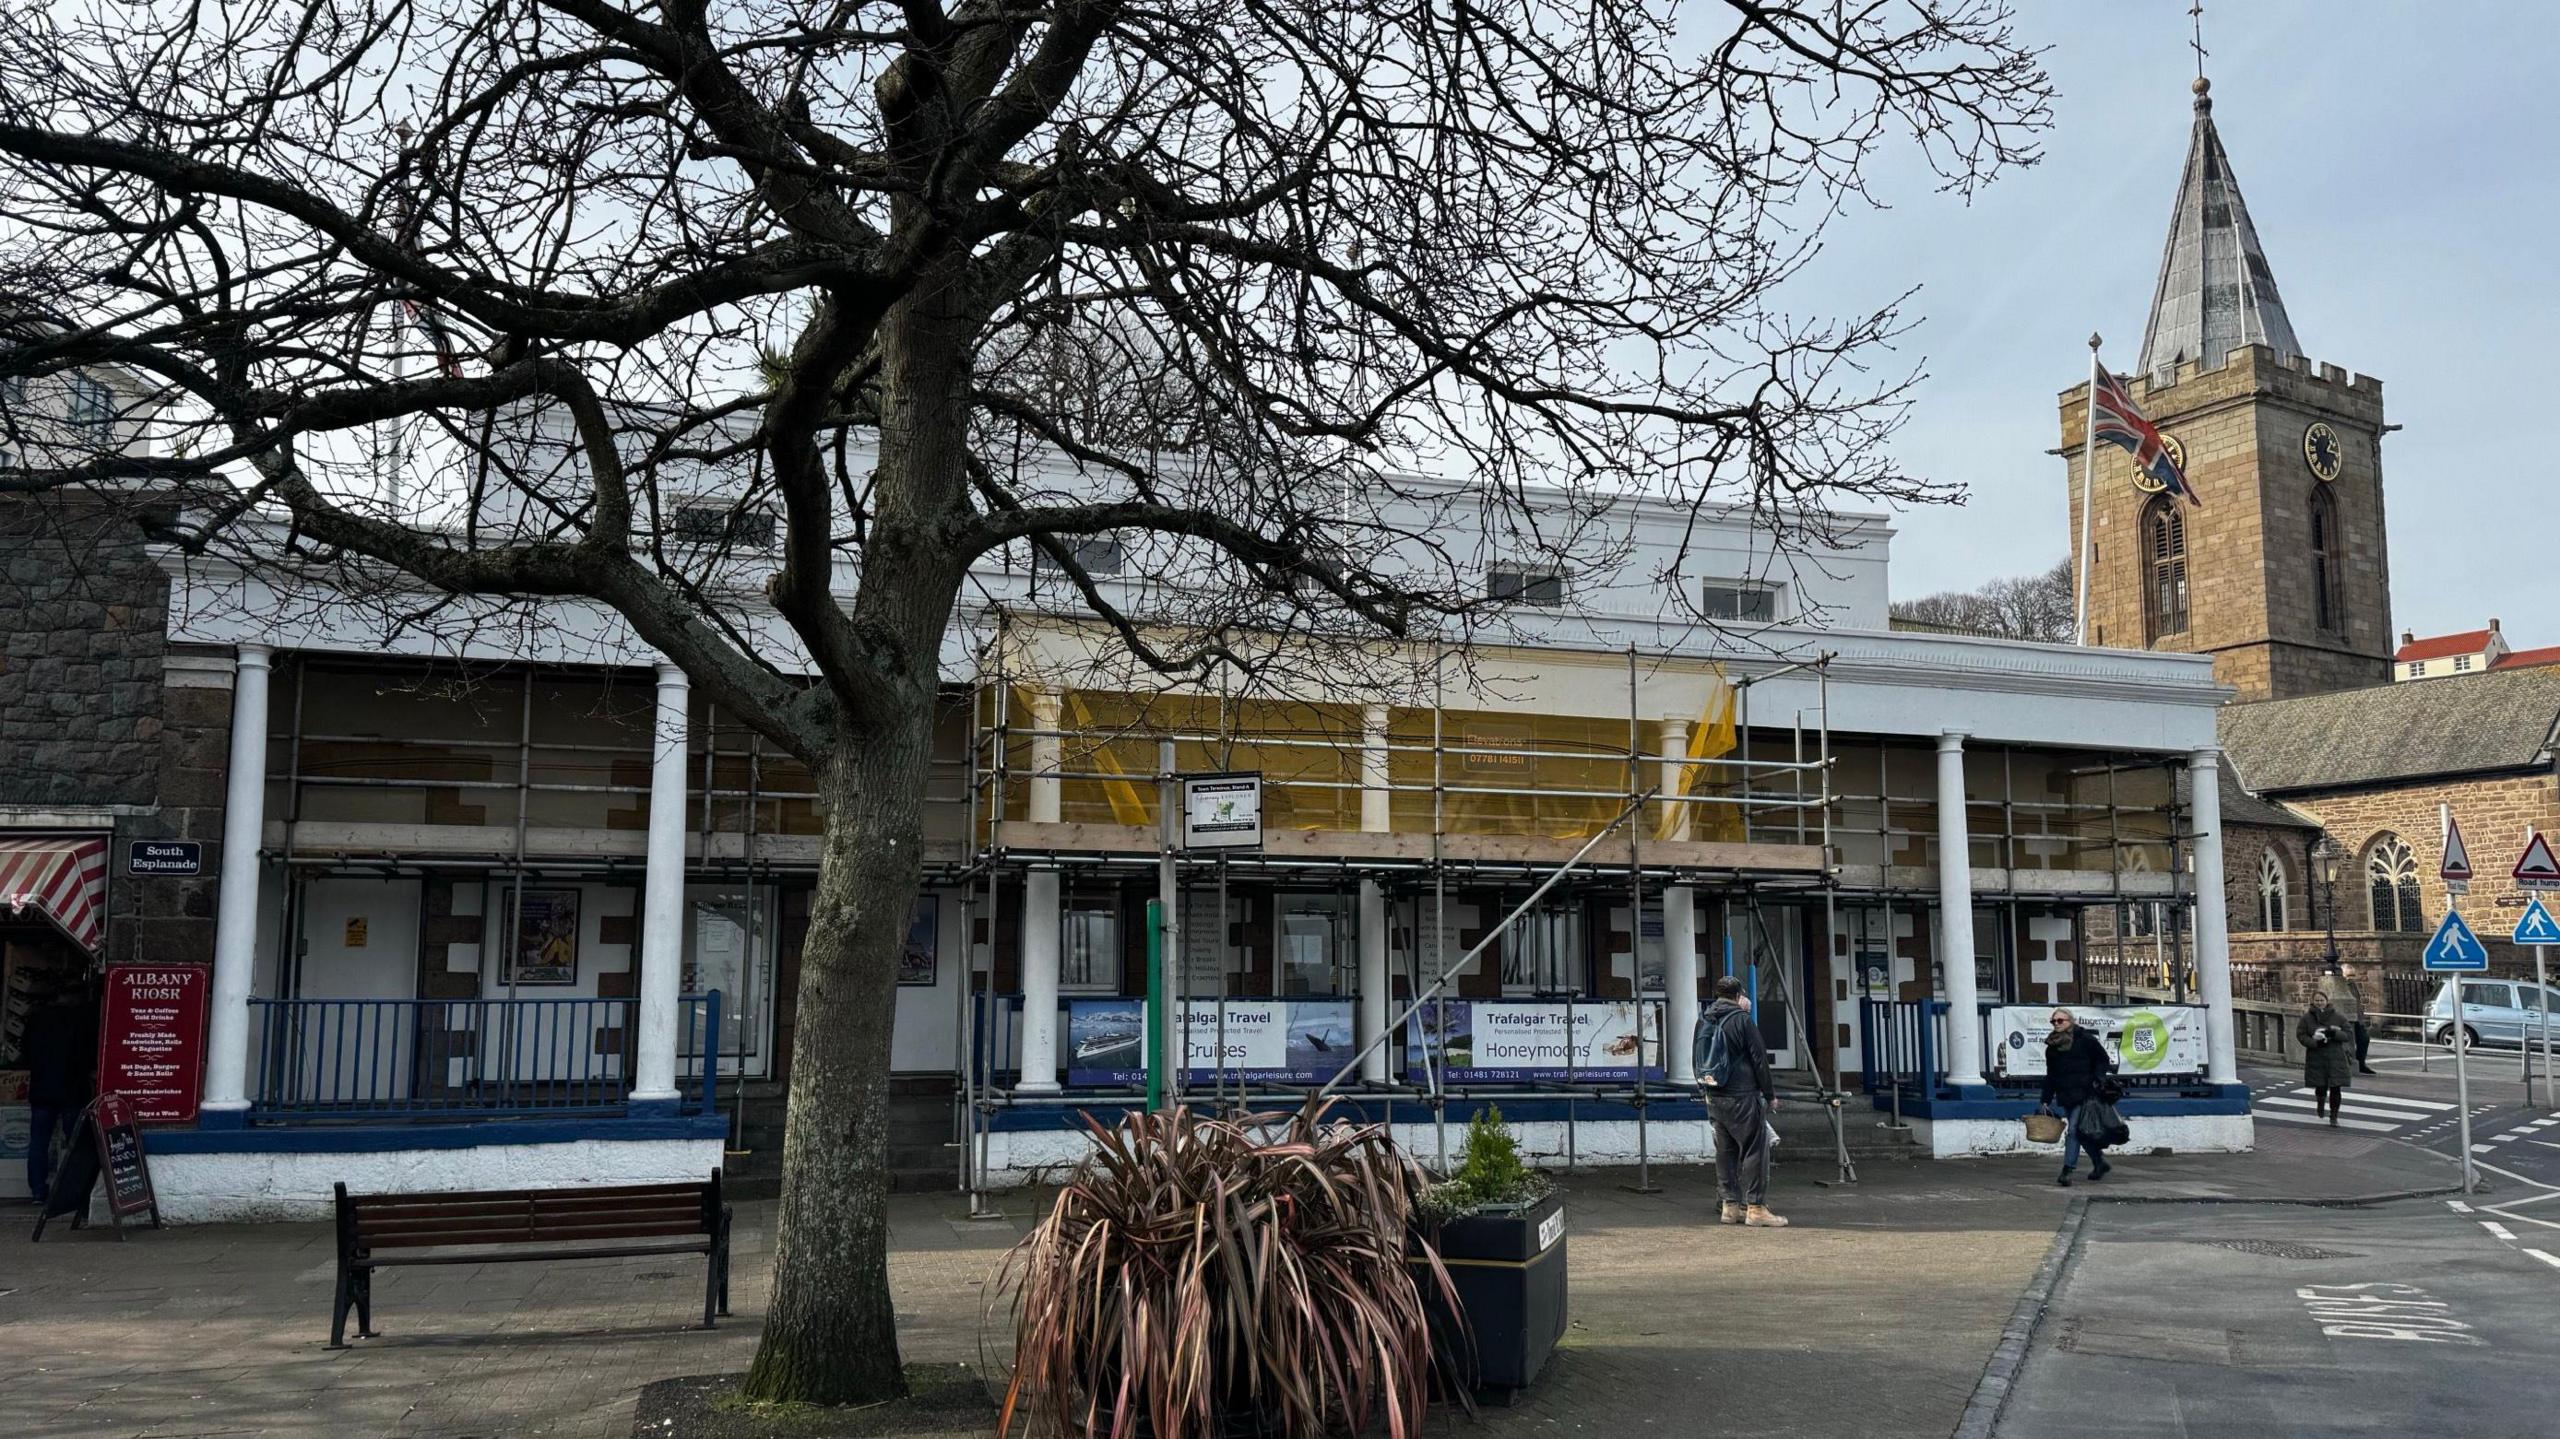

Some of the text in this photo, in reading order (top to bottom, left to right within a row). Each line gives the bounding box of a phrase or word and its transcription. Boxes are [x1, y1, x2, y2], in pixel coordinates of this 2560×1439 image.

[1471, 754, 1497, 763] 07781
[146, 846, 184, 856] South
[132, 858, 197, 870] Esplanade
[2519, 878, 2560, 887] Road hump
[122, 973, 192, 985] ALBANY
[131, 988, 181, 1000] KIOSK
[1227, 1012, 1271, 1024] Travel
[1487, 1013, 1545, 1027] Trafalgar
[1243, 1028, 1263, 1036] Travel
[1494, 1028, 1532, 1036] Personalised
[1533, 1028, 1562, 1036] Protected
[1486, 1043, 1591, 1061] Honeymoons
[1113, 1072, 1129, 1081] Tel:
[1448, 1071, 1520, 1080] Tel: 01481 728121
[2294, 1281, 2491, 1347] BUSES
